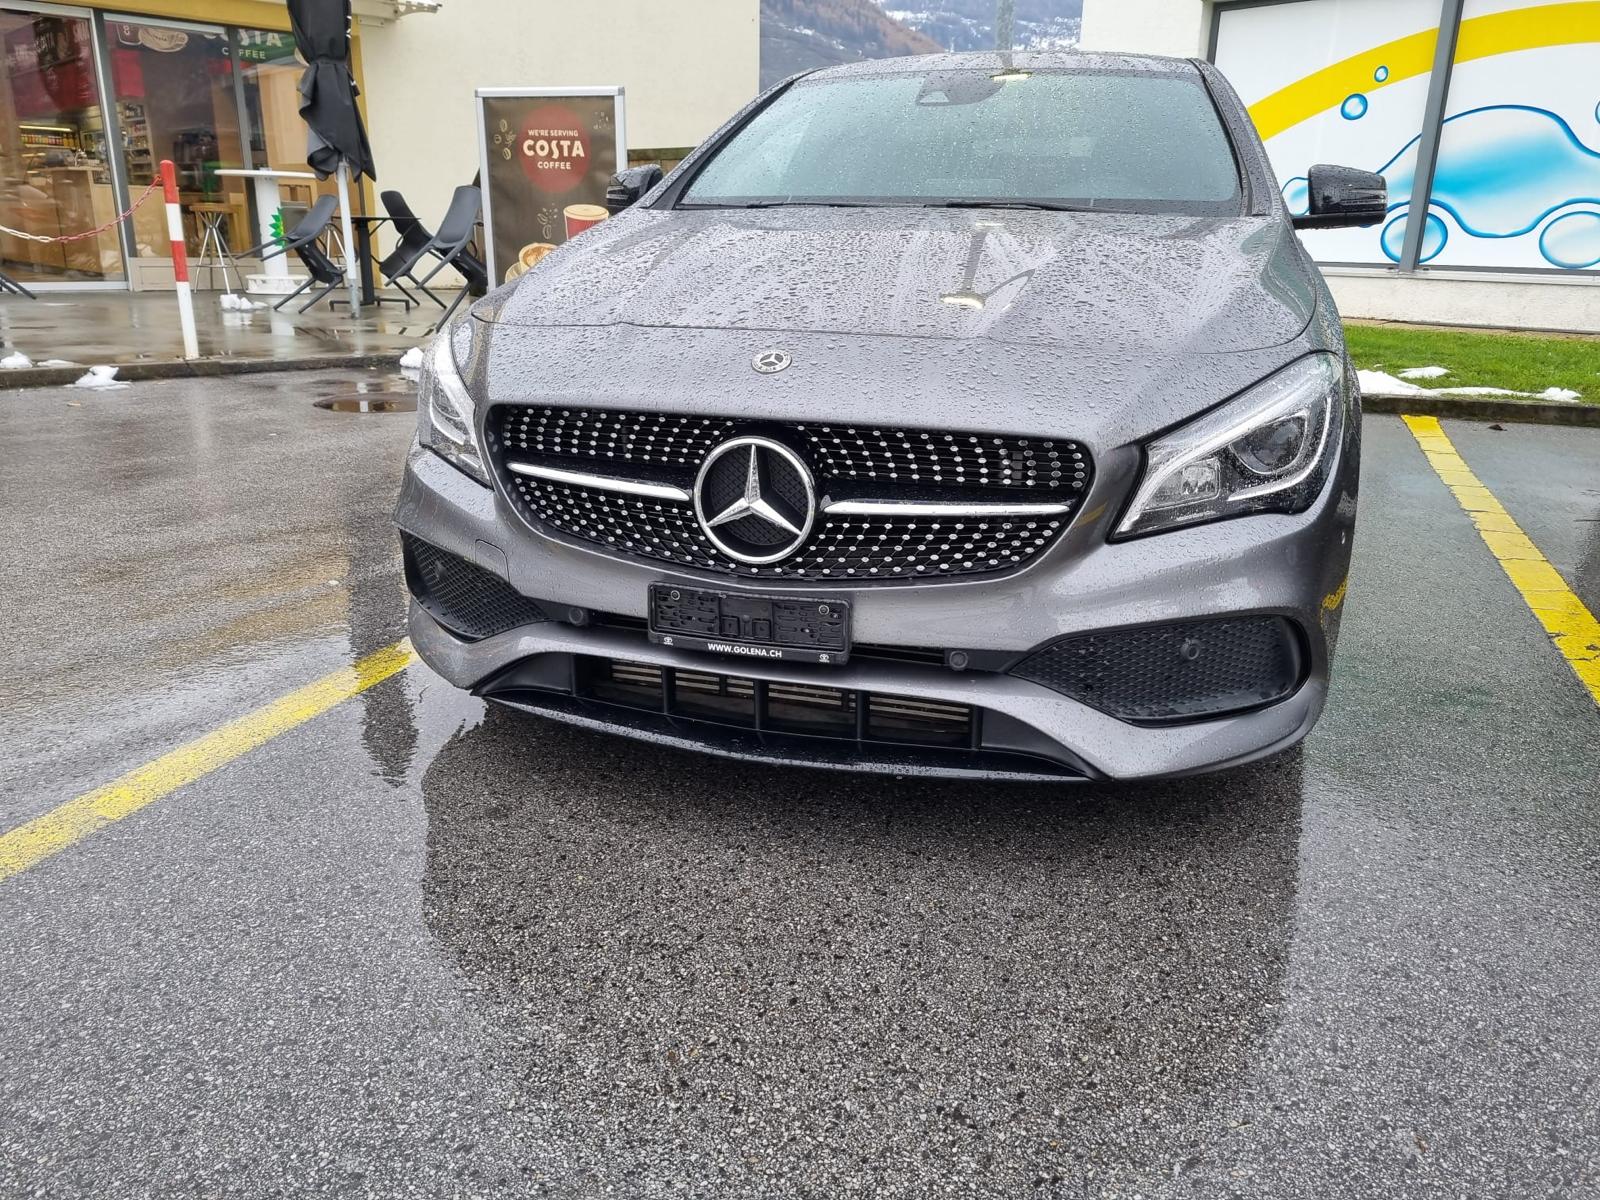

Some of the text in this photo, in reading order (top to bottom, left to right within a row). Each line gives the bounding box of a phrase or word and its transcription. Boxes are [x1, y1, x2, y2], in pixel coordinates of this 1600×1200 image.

[221, 46, 266, 59] CFFEE
[527, 129, 579, 137] WE'RE SERVING
[522, 139, 585, 159] COSTA
[537, 161, 571, 170] COFFEE
[707, 642, 783, 659] WWW.GOLENA.CH
